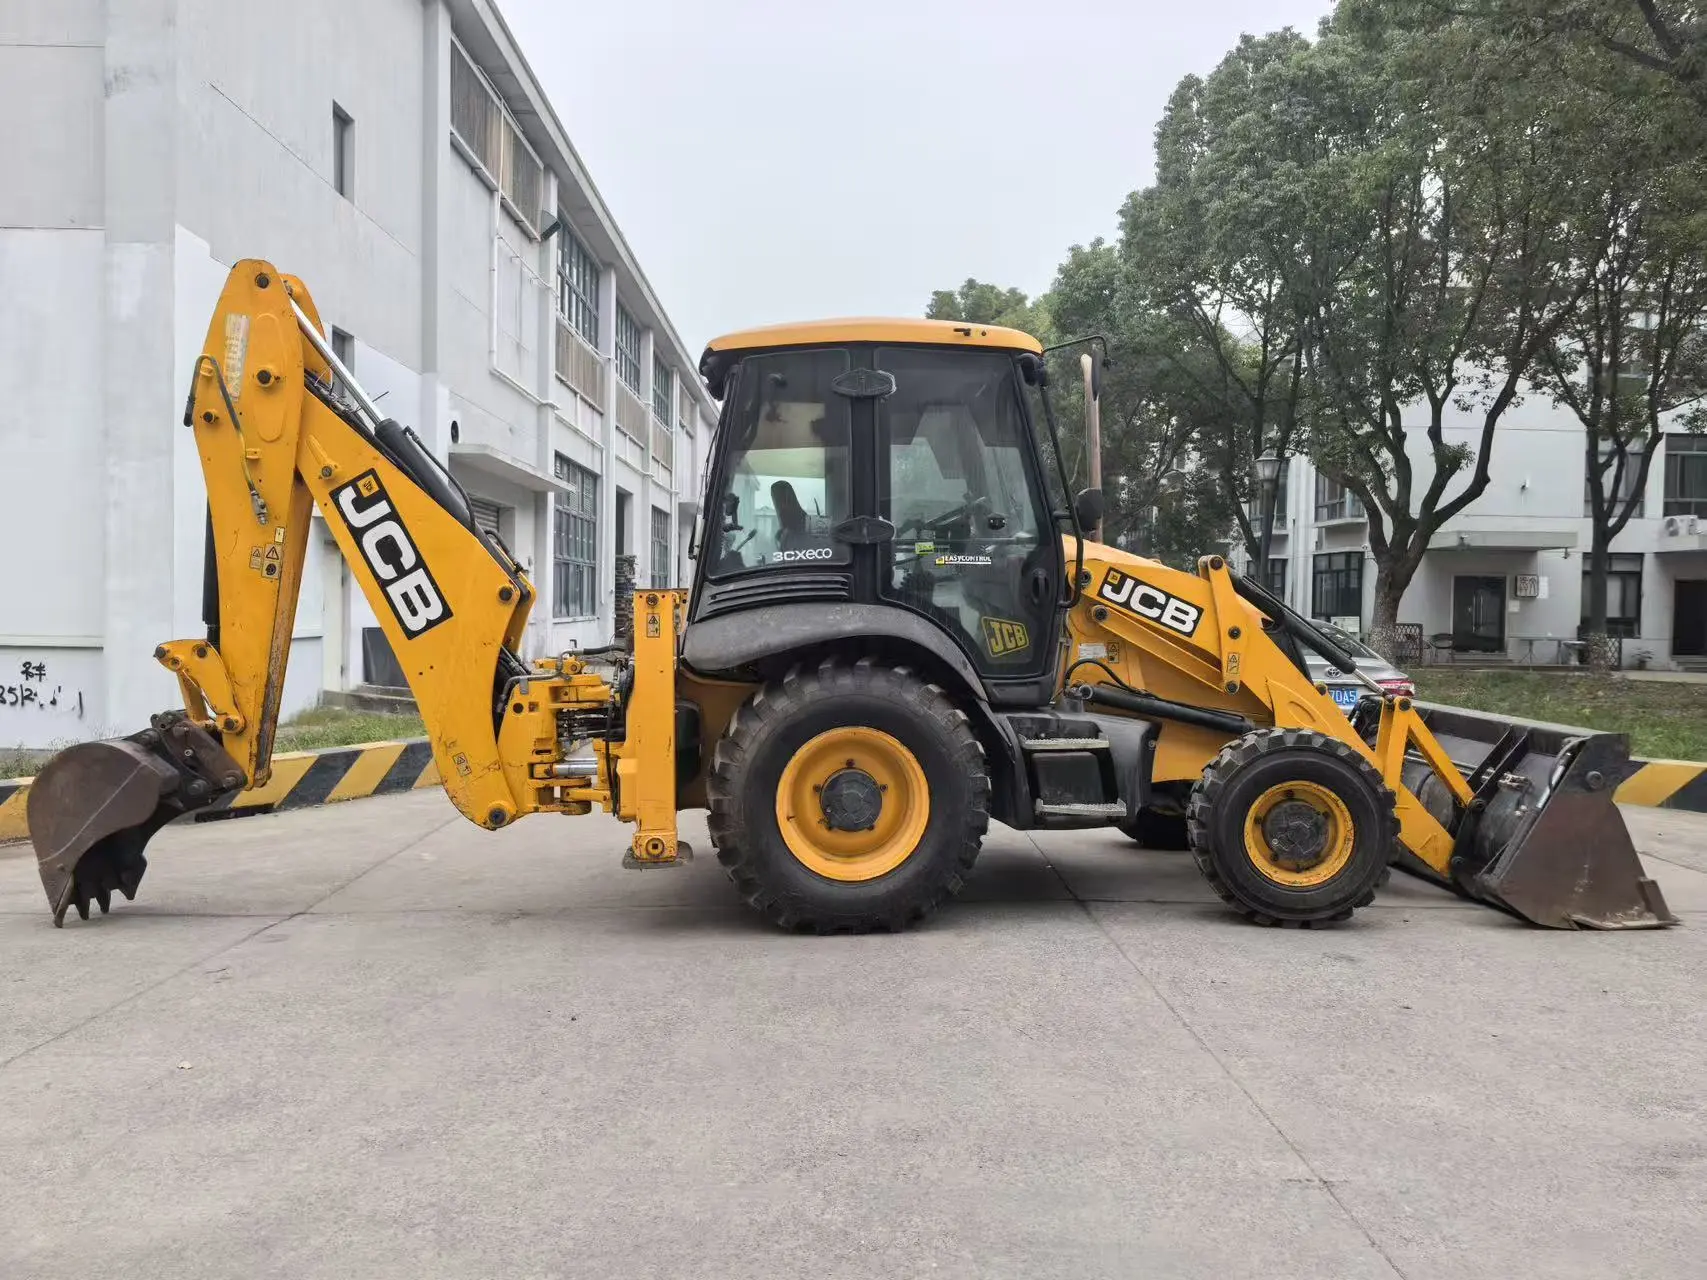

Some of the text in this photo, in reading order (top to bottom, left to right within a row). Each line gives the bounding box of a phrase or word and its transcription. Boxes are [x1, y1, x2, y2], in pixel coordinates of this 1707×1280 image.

[339, 486, 443, 631] JCB
[1102, 578, 1198, 633] JCB
[989, 621, 1026, 653] JCB
